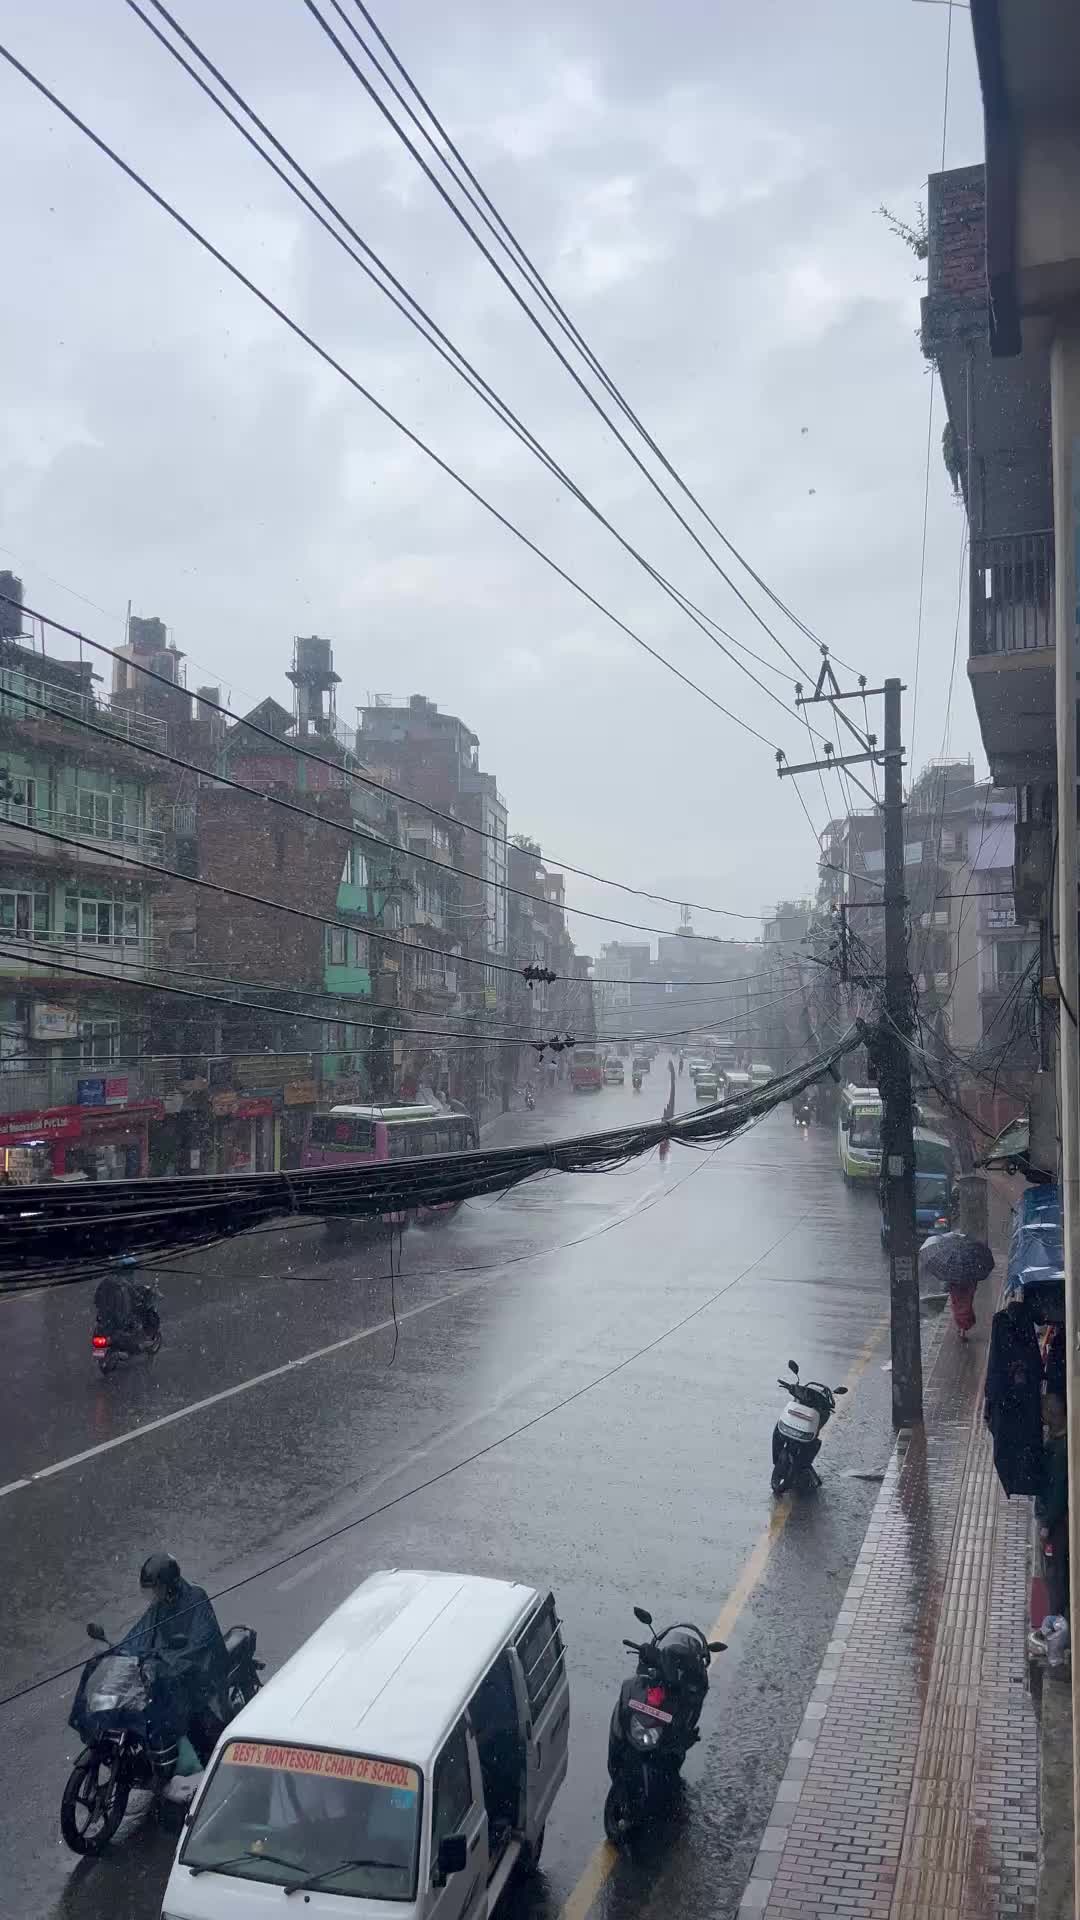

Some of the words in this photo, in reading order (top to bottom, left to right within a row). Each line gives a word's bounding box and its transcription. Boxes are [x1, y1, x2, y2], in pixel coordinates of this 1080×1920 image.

[264, 1747, 324, 1772] MONTESSORI
[325, 1755, 355, 1777] CHAIN
[357, 1758, 369, 1777] OF
[370, 1762, 409, 1786] SCHOOL
